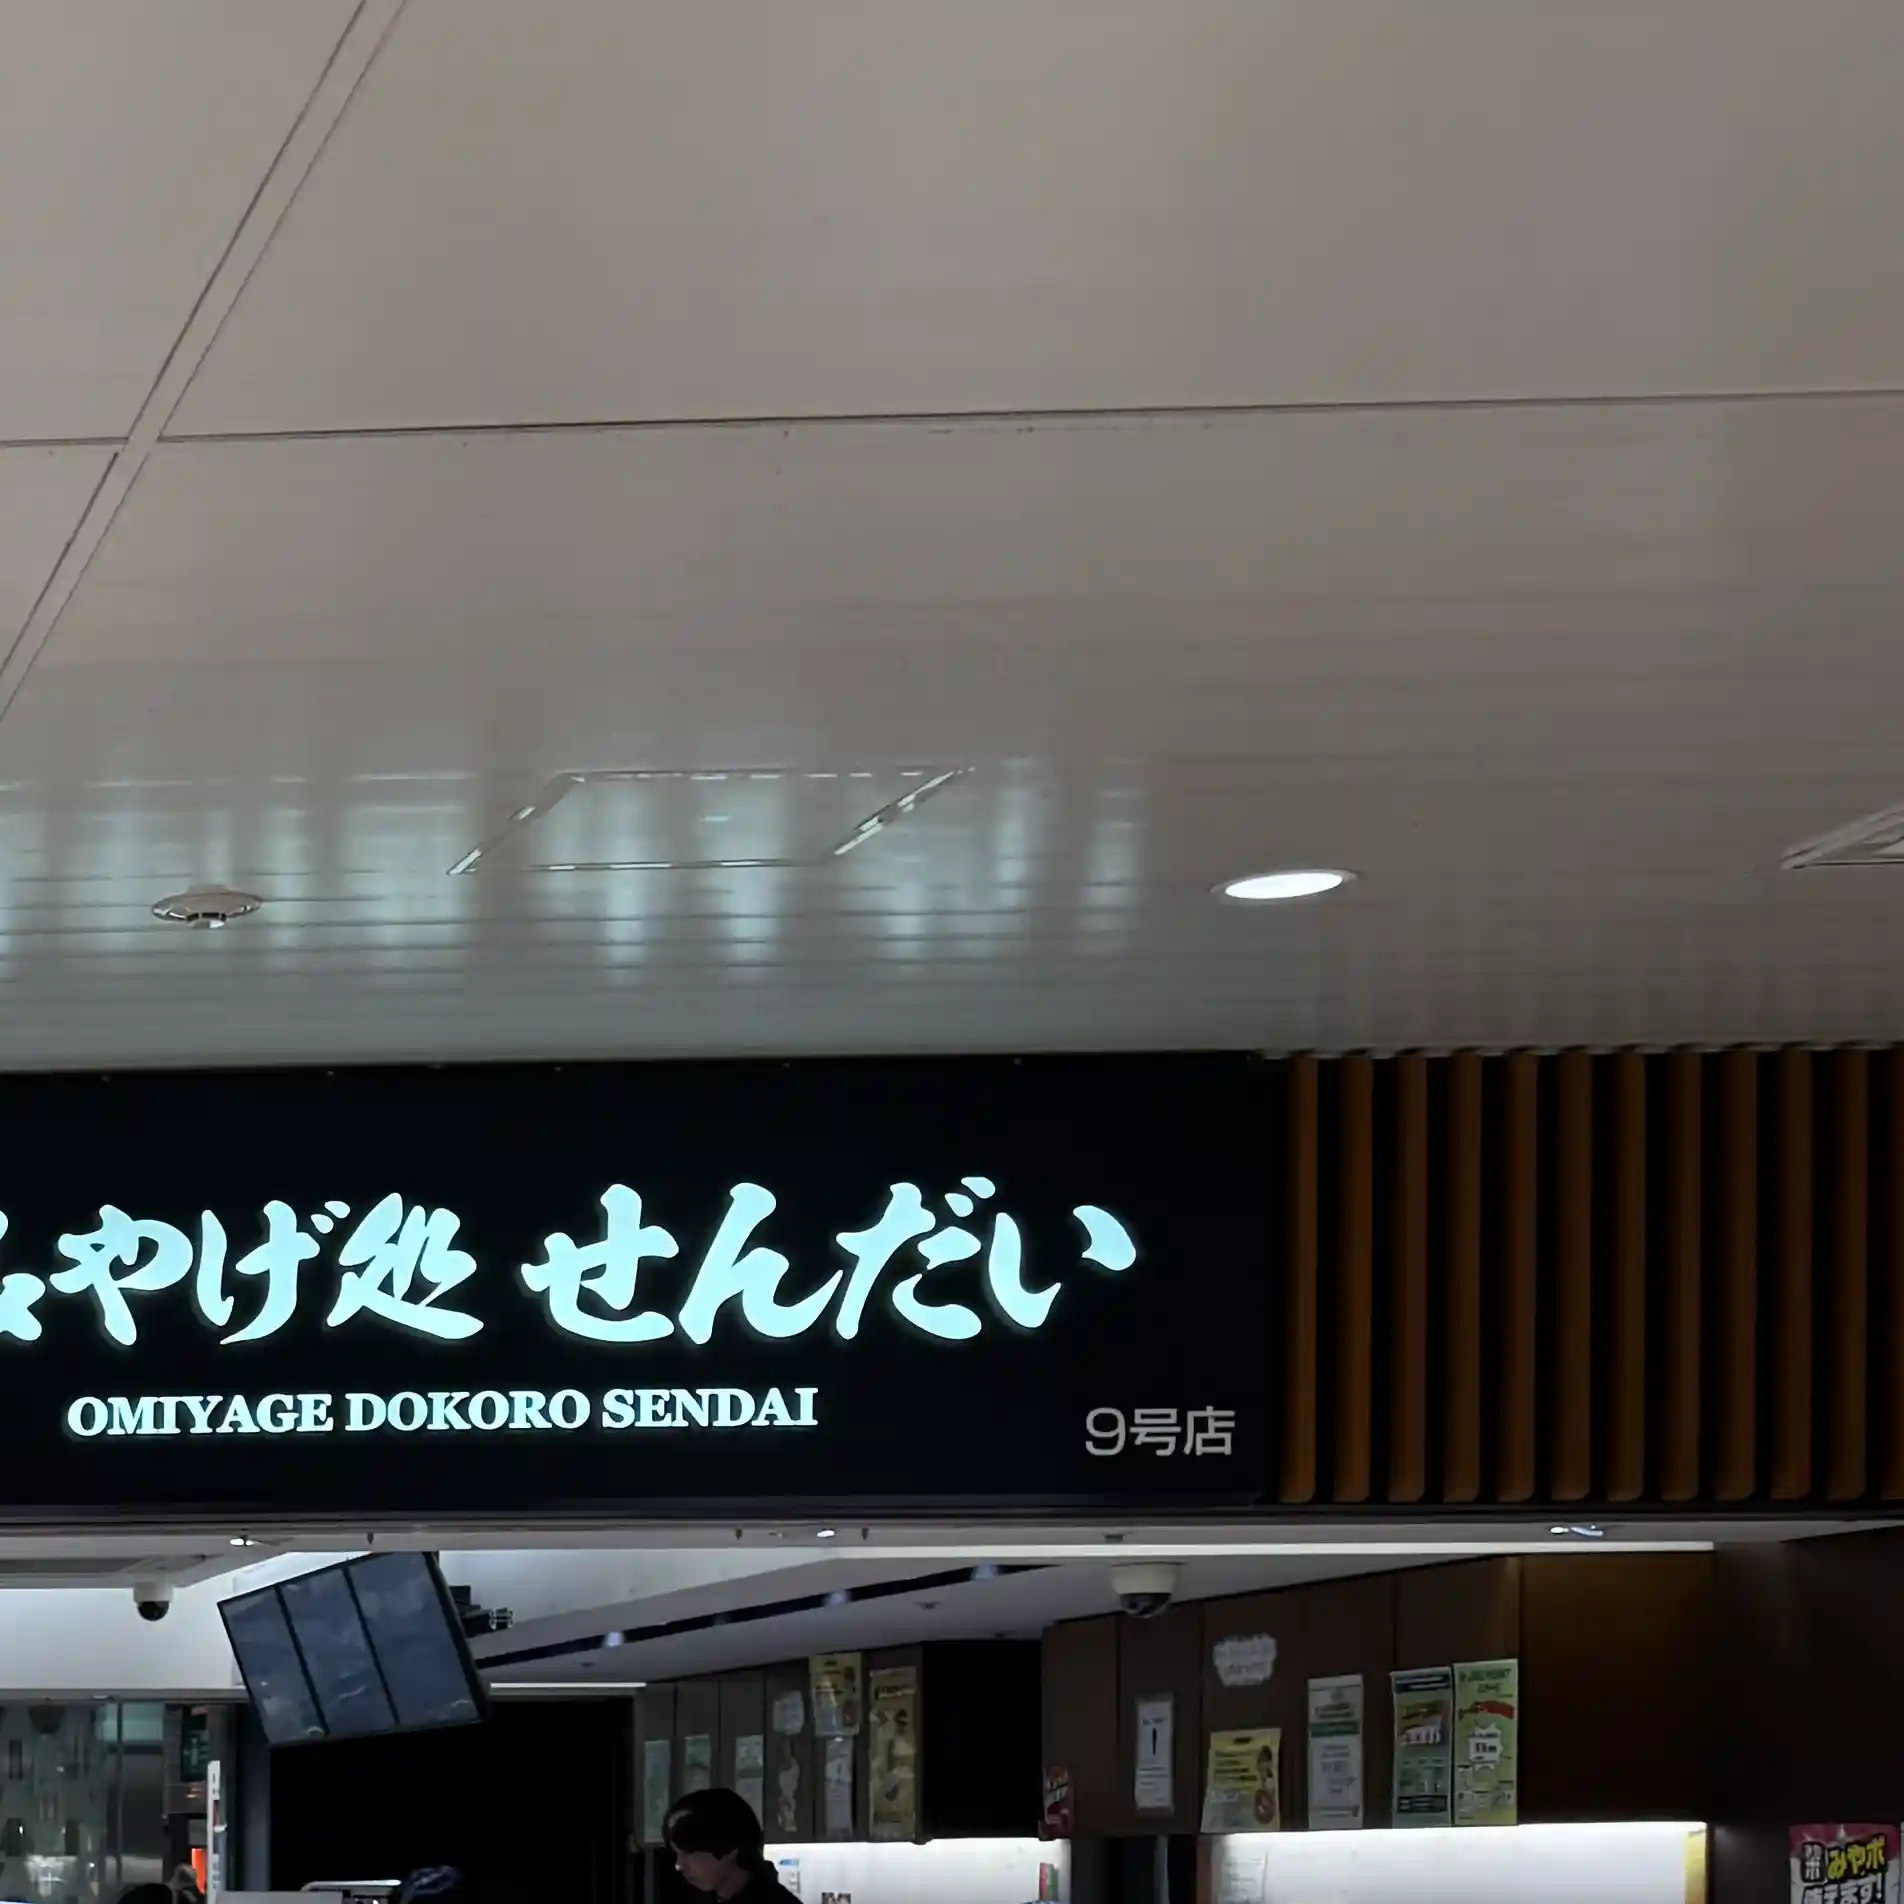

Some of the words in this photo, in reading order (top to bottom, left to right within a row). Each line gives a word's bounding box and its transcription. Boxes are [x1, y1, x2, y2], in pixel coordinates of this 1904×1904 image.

[521, 1177, 1135, 1344] せんだい
[68, 1389, 332, 1435] OMIYAGE
[345, 1389, 589, 1433] DOKORO
[602, 1388, 817, 1429] SENDAI
[1084, 1406, 1235, 1456] 9号店
